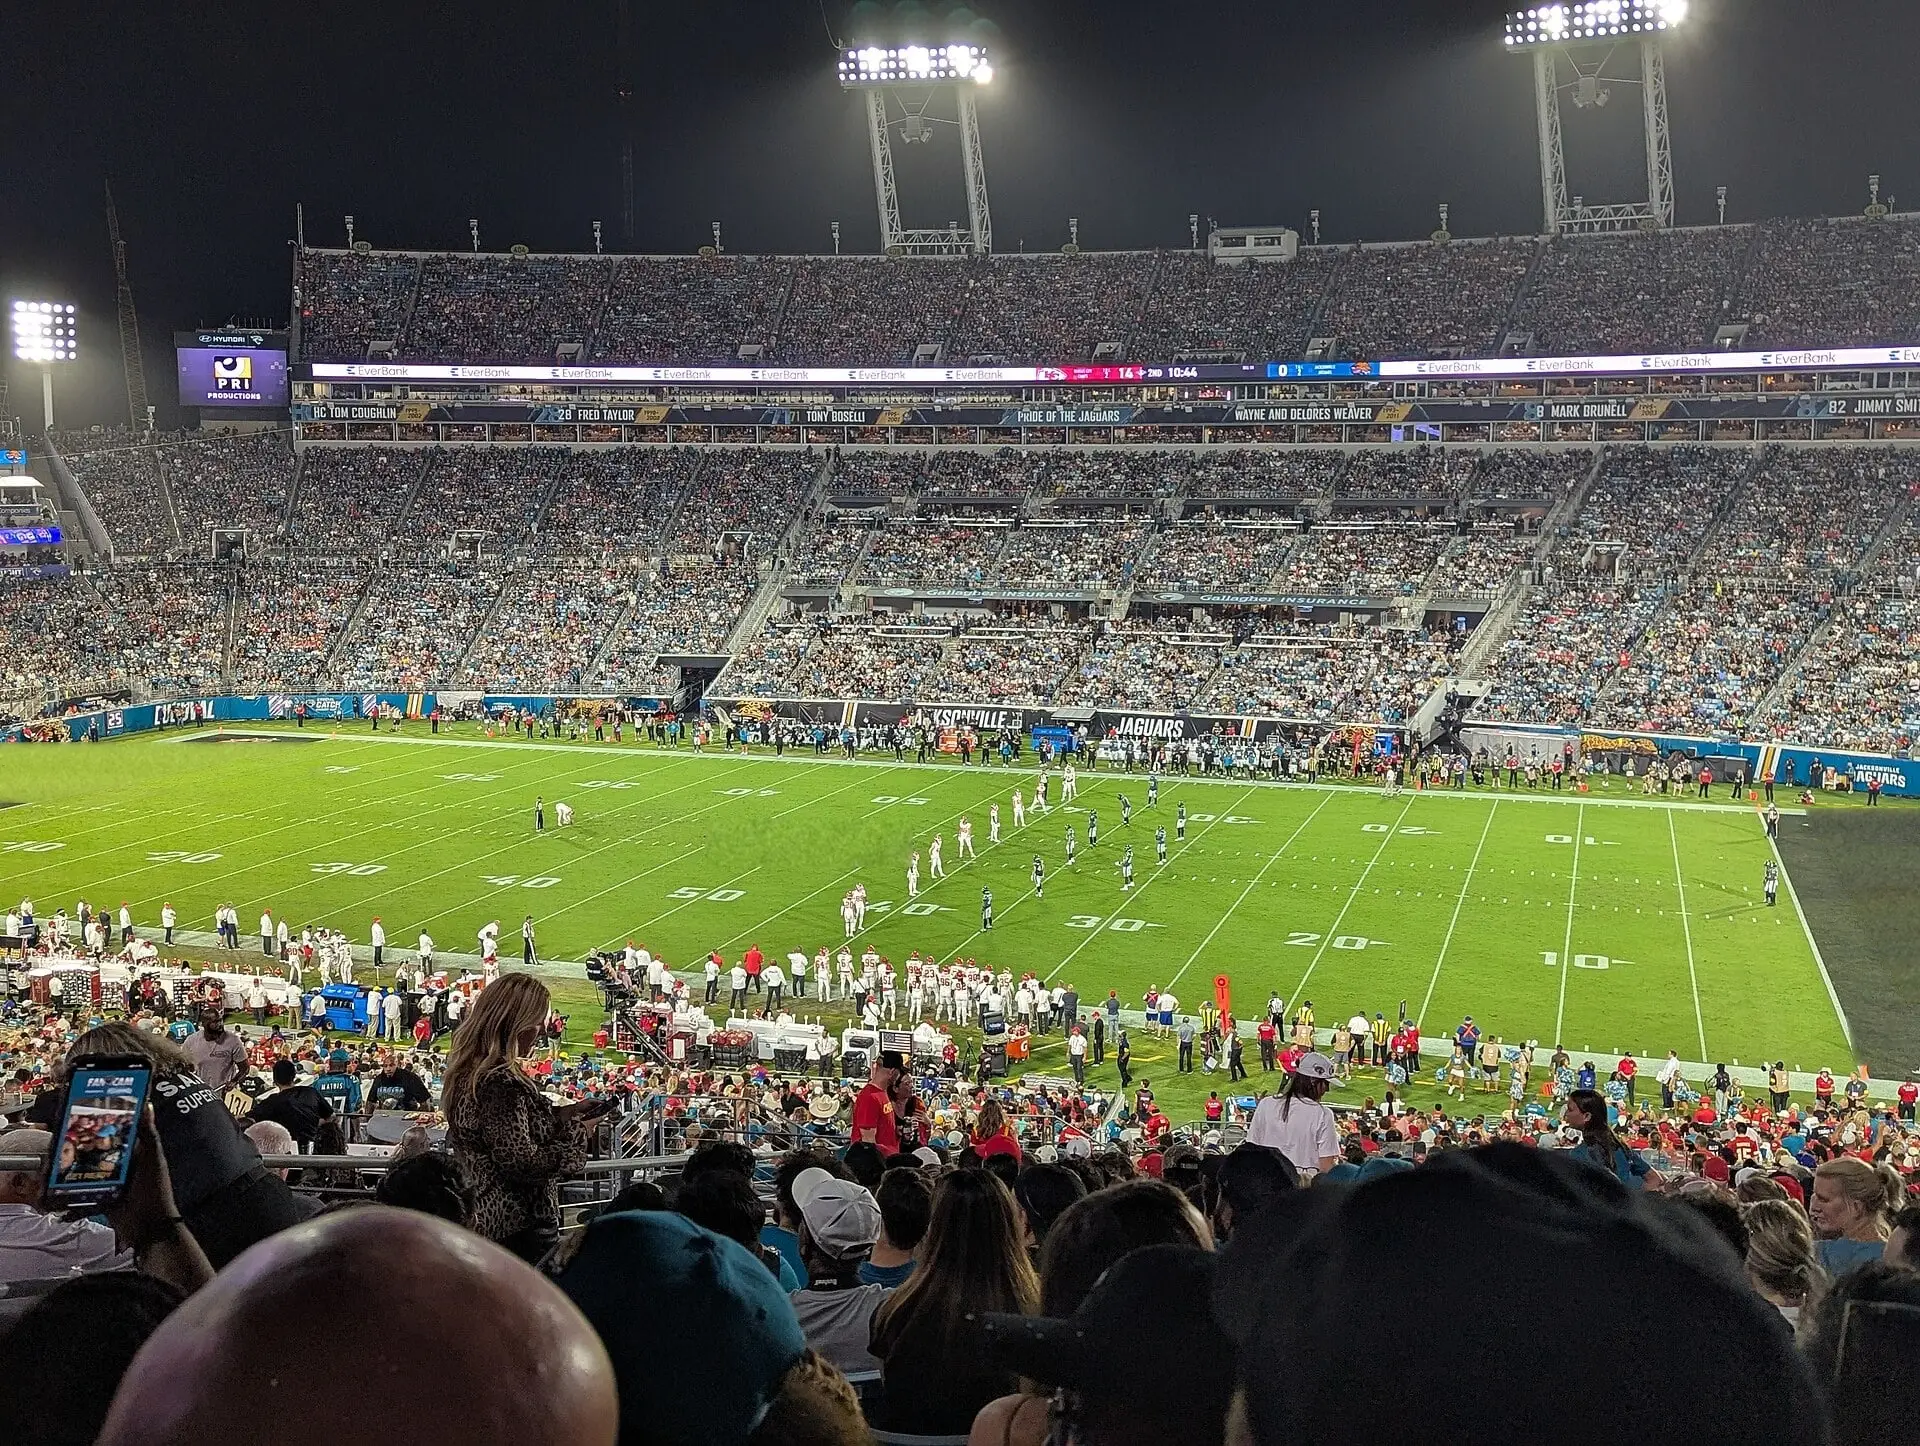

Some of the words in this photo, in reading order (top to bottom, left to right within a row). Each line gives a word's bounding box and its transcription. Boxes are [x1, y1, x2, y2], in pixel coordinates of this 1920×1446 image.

[1654, 356, 1712, 368] EverBank
[1775, 352, 1837, 365] EverBank
[1278, 364, 1288, 377] 0
[1429, 362, 1482, 373] EverBank
[1539, 359, 1594, 371] EverBank
[358, 366, 409, 377] EverBank
[462, 367, 511, 378] EverBank
[562, 368, 614, 379] EverBank
[664, 369, 712, 380] EverBank
[762, 369, 809, 380] EverBank
[859, 370, 906, 380] EverBank
[956, 370, 1004, 380] EverBank
[1119, 367, 1134, 379] 14
[1148, 369, 1163, 378] 2ND
[1168, 367, 1198, 378] 10:44
[217, 378, 250, 390] PRI
[207, 392, 261, 400] PRODUCTIONS
[1536, 405, 1545, 418] 8
[1551, 404, 1580, 418] MARK
[1583, 404, 1627, 417] BRUNELL
[1828, 400, 1846, 414] 82
[1854, 399, 1893, 414] JIMMY
[313, 407, 327, 418] HC
[329, 407, 349, 419] TOM
[351, 407, 397, 419] COUGHLIN
[558, 409, 572, 420] 28
[578, 410, 600, 420] FRED
[603, 409, 635, 421] TAYLOR
[807, 411, 829, 422] TONY
[831, 411, 865, 422] BOSELLI
[1017, 411, 1043, 422] PRIDE
[1046, 411, 1058, 422] OF
[1059, 411, 1076, 422] THE
[1079, 410, 1120, 422] JAGUARS
[1234, 408, 1267, 421] WAYNE
[1268, 408, 1288, 420] AND
[1290, 408, 1331, 420] DELORES
[1333, 407, 1372, 420] WEAVER
[1001, 591, 1084, 599] INSURANCE
[1280, 597, 1369, 605] INSURANCE
[107, 711, 122, 727] 25
[1117, 717, 1185, 738] JAGUARS
[1855, 764, 1901, 774] JACKSONVILLE
[256, 1052, 266, 1065] 15
